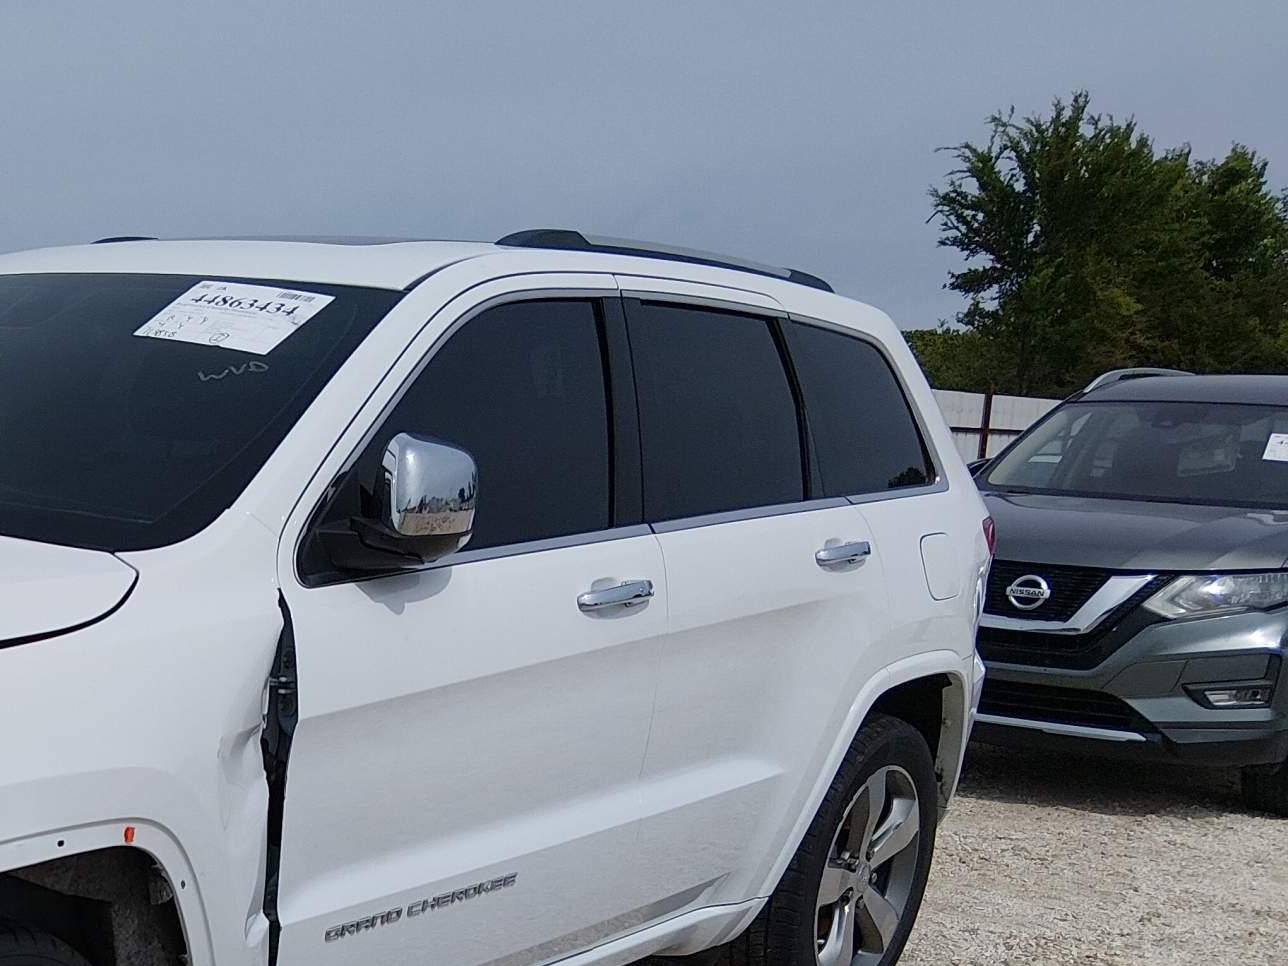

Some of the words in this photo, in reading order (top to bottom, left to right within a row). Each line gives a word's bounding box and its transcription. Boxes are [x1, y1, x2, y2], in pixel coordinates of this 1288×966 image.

[190, 293, 300, 317] 44863434
[1010, 587, 1045, 597] NISSAN
[324, 906, 403, 943] GRAND
[406, 872, 518, 918] CHEROKEE
